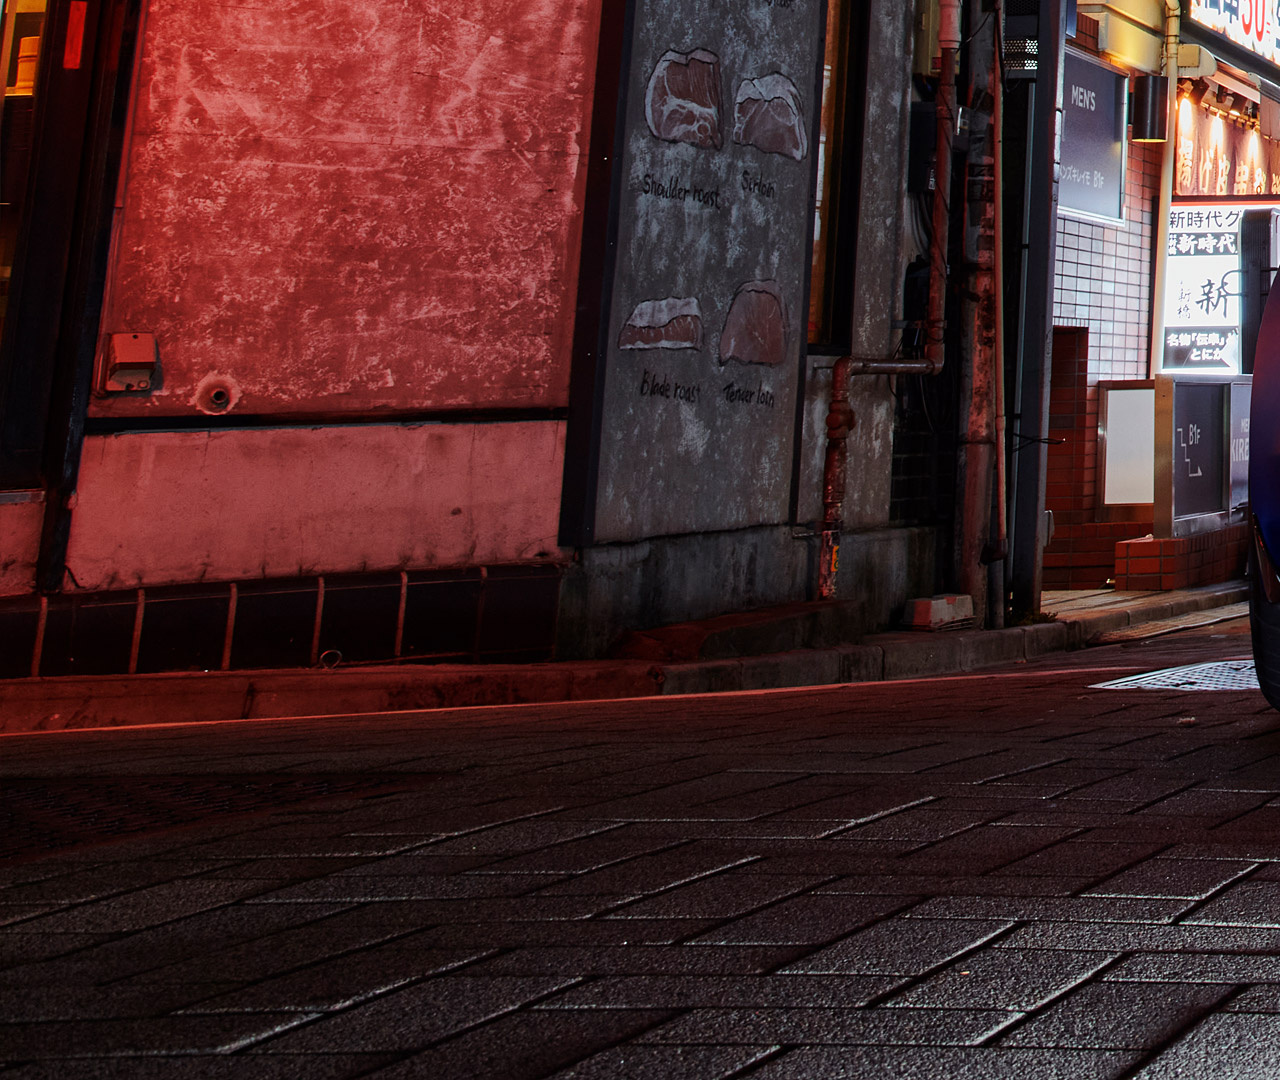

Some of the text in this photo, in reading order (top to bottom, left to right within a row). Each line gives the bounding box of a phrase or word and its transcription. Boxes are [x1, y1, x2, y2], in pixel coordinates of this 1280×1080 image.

[1071, 84, 1097, 112] MEN'S
[642, 173, 721, 210] Shoulder roast
[741, 169, 776, 200] Sirloin
[640, 368, 701, 404] Blade roast
